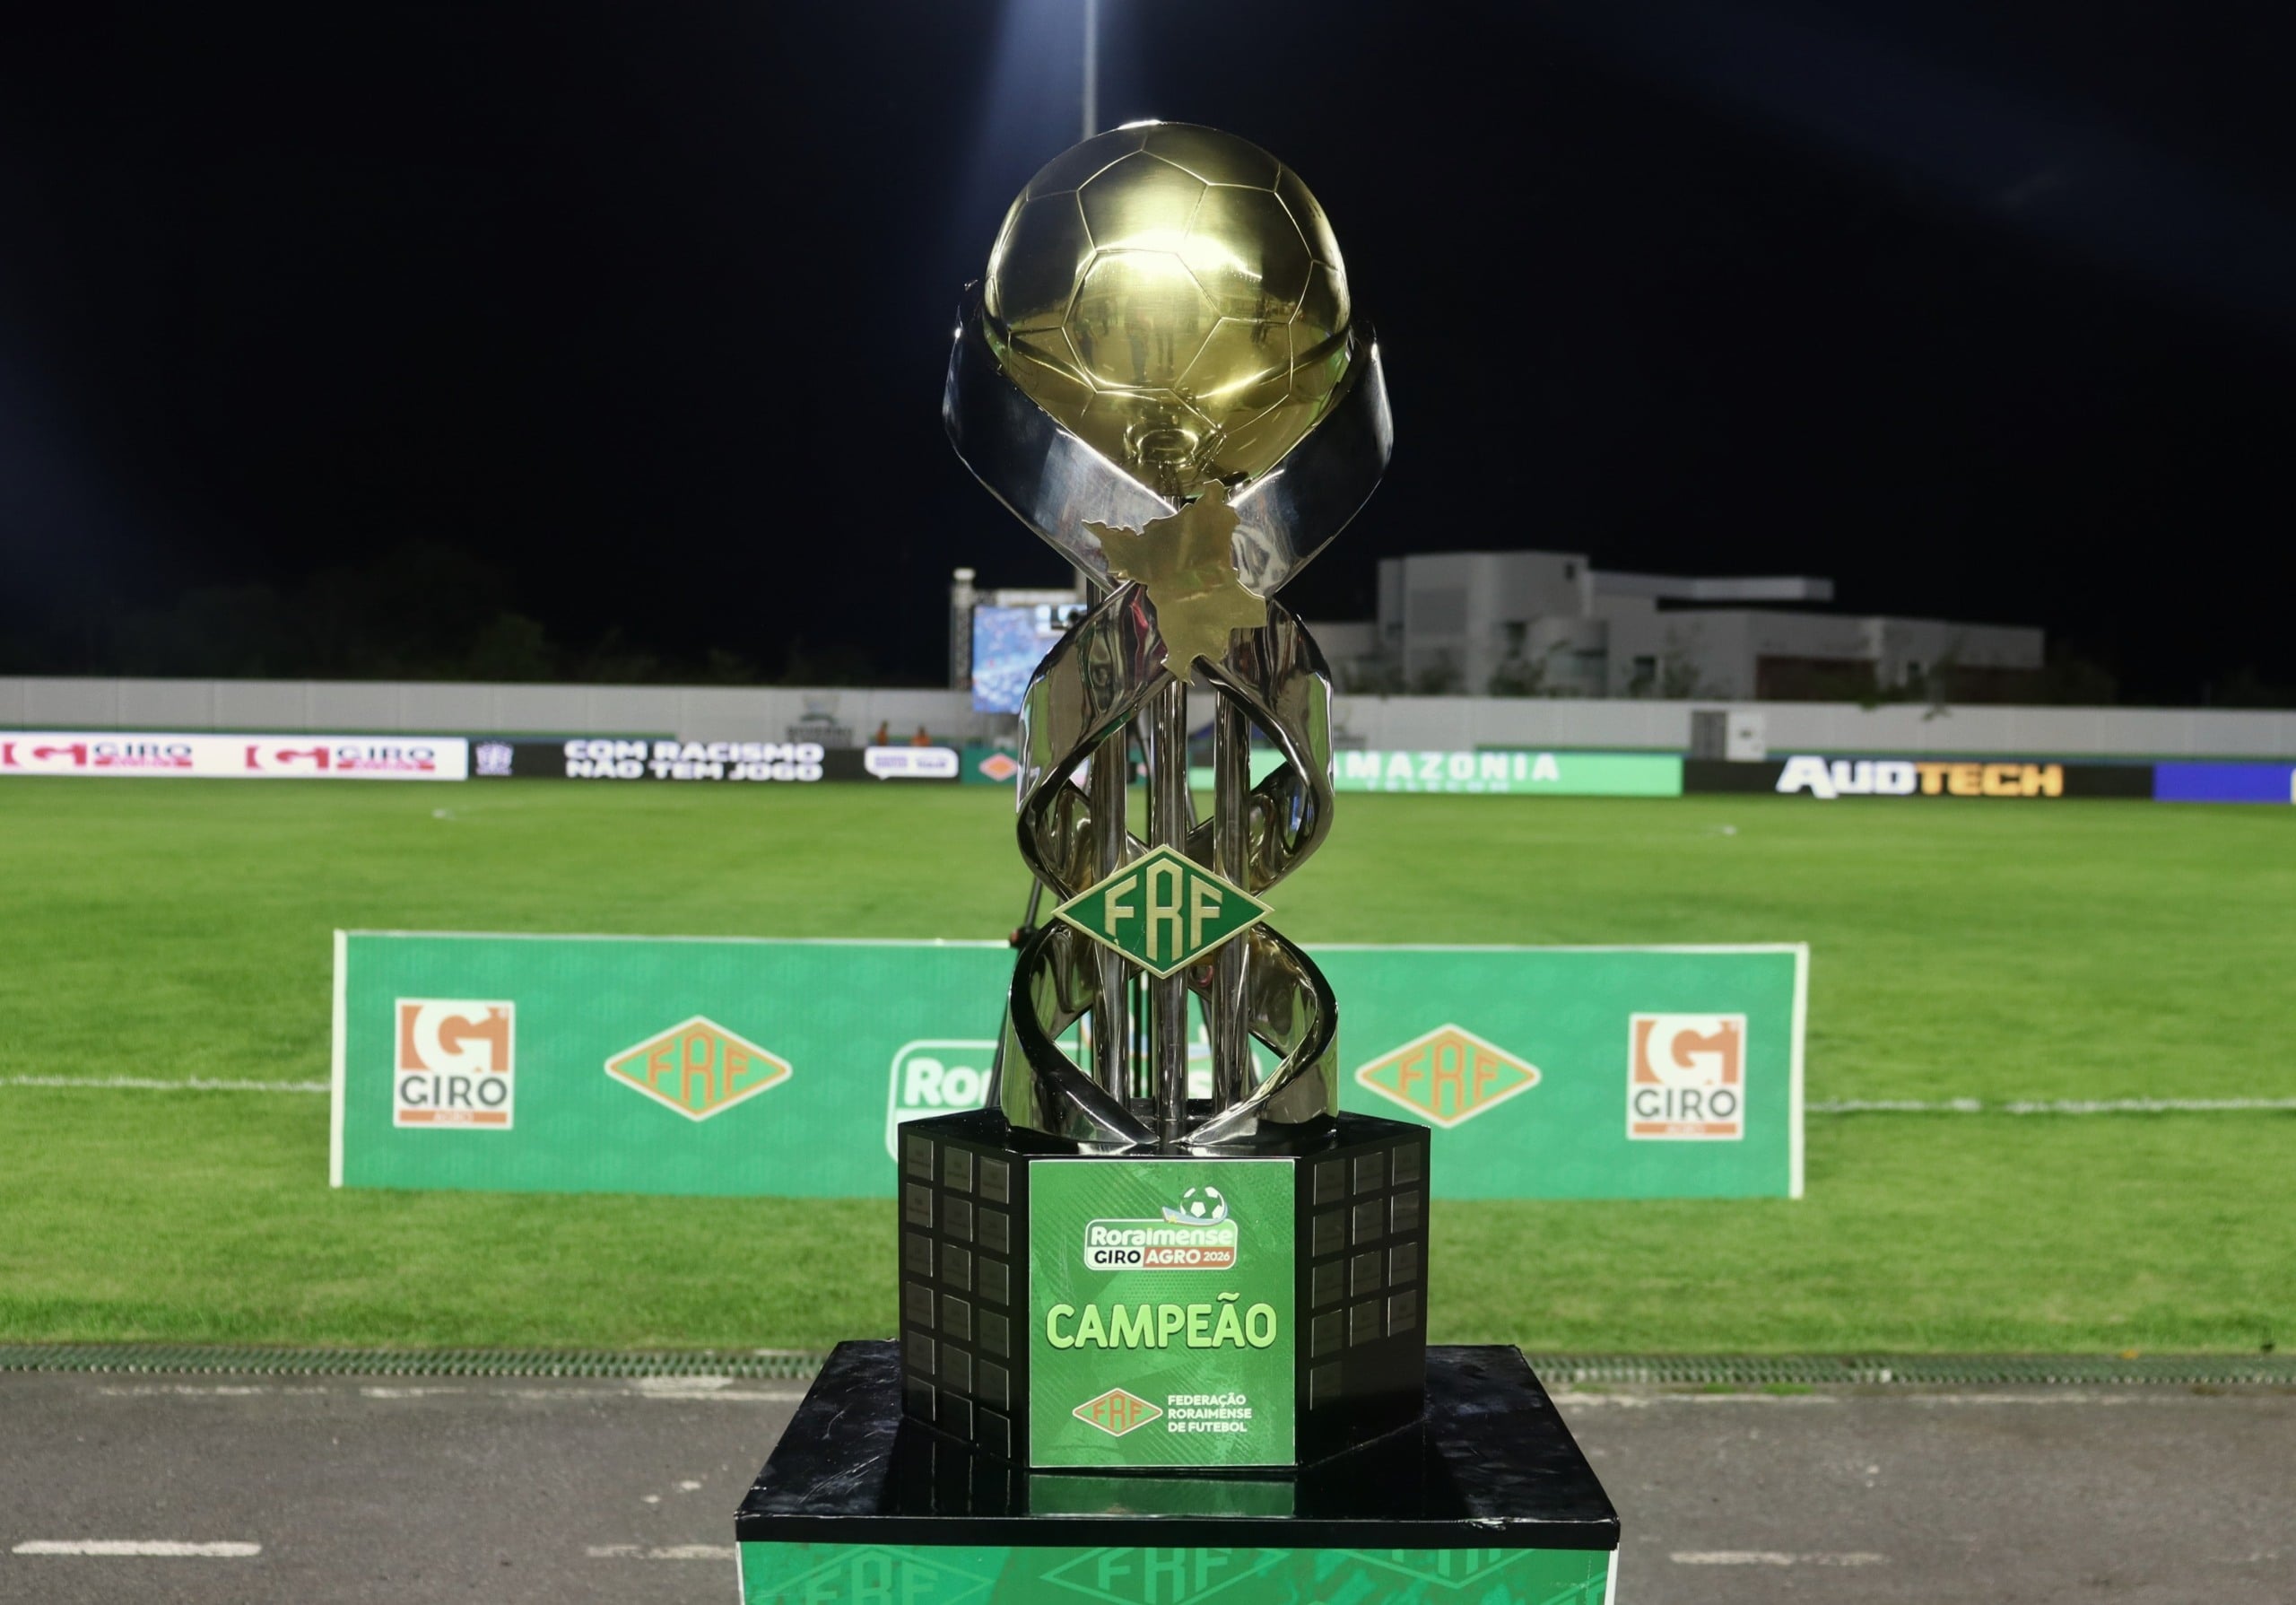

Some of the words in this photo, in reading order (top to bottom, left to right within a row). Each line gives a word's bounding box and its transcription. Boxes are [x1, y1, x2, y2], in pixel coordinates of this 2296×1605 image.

[564, 740, 648, 761] COM
[653, 741, 824, 763] RACISMO
[649, 761, 723, 780] TEM
[728, 763, 823, 781] JOGO
[1334, 752, 1559, 781] MAZONIA
[1105, 858, 1223, 963] FRF
[400, 1075, 508, 1108] GIRO
[1634, 1088, 1736, 1120] GIRO
[1091, 1226, 1233, 1246] Roraimense
[1094, 1250, 1141, 1264] GIRO
[1145, 1249, 1201, 1264] AGRO
[1204, 1252, 1231, 1262] 2026
[1046, 1292, 1277, 1348] CAMPEÃO
[1168, 1392, 1247, 1408] FEDERAÇÃO
[1168, 1408, 1252, 1419] RORAIMENSE
[1168, 1422, 1187, 1433] DE
[1188, 1422, 1248, 1433] FUTEBOL
